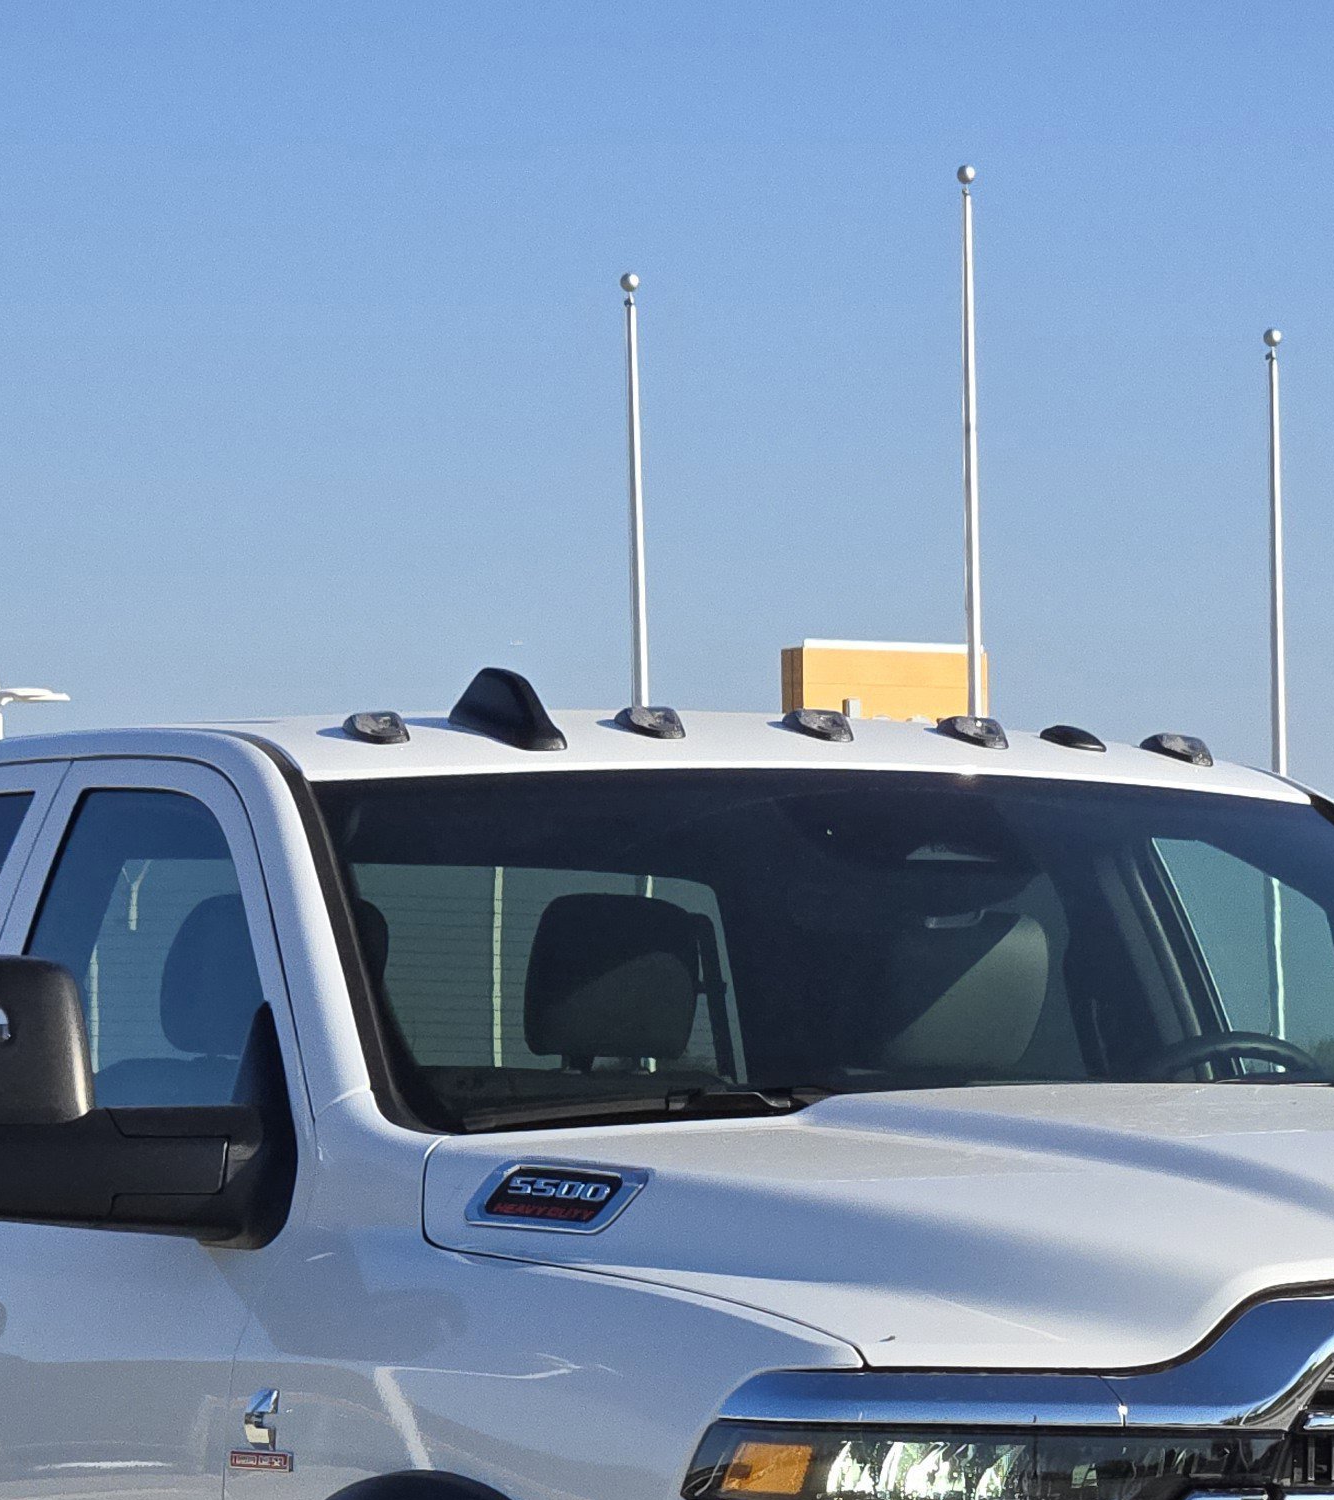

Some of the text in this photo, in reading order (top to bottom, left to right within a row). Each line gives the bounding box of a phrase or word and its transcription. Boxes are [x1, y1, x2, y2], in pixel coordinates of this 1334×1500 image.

[507, 1177, 611, 1202] 5500
[493, 1203, 595, 1221] HEAVY DUTY
